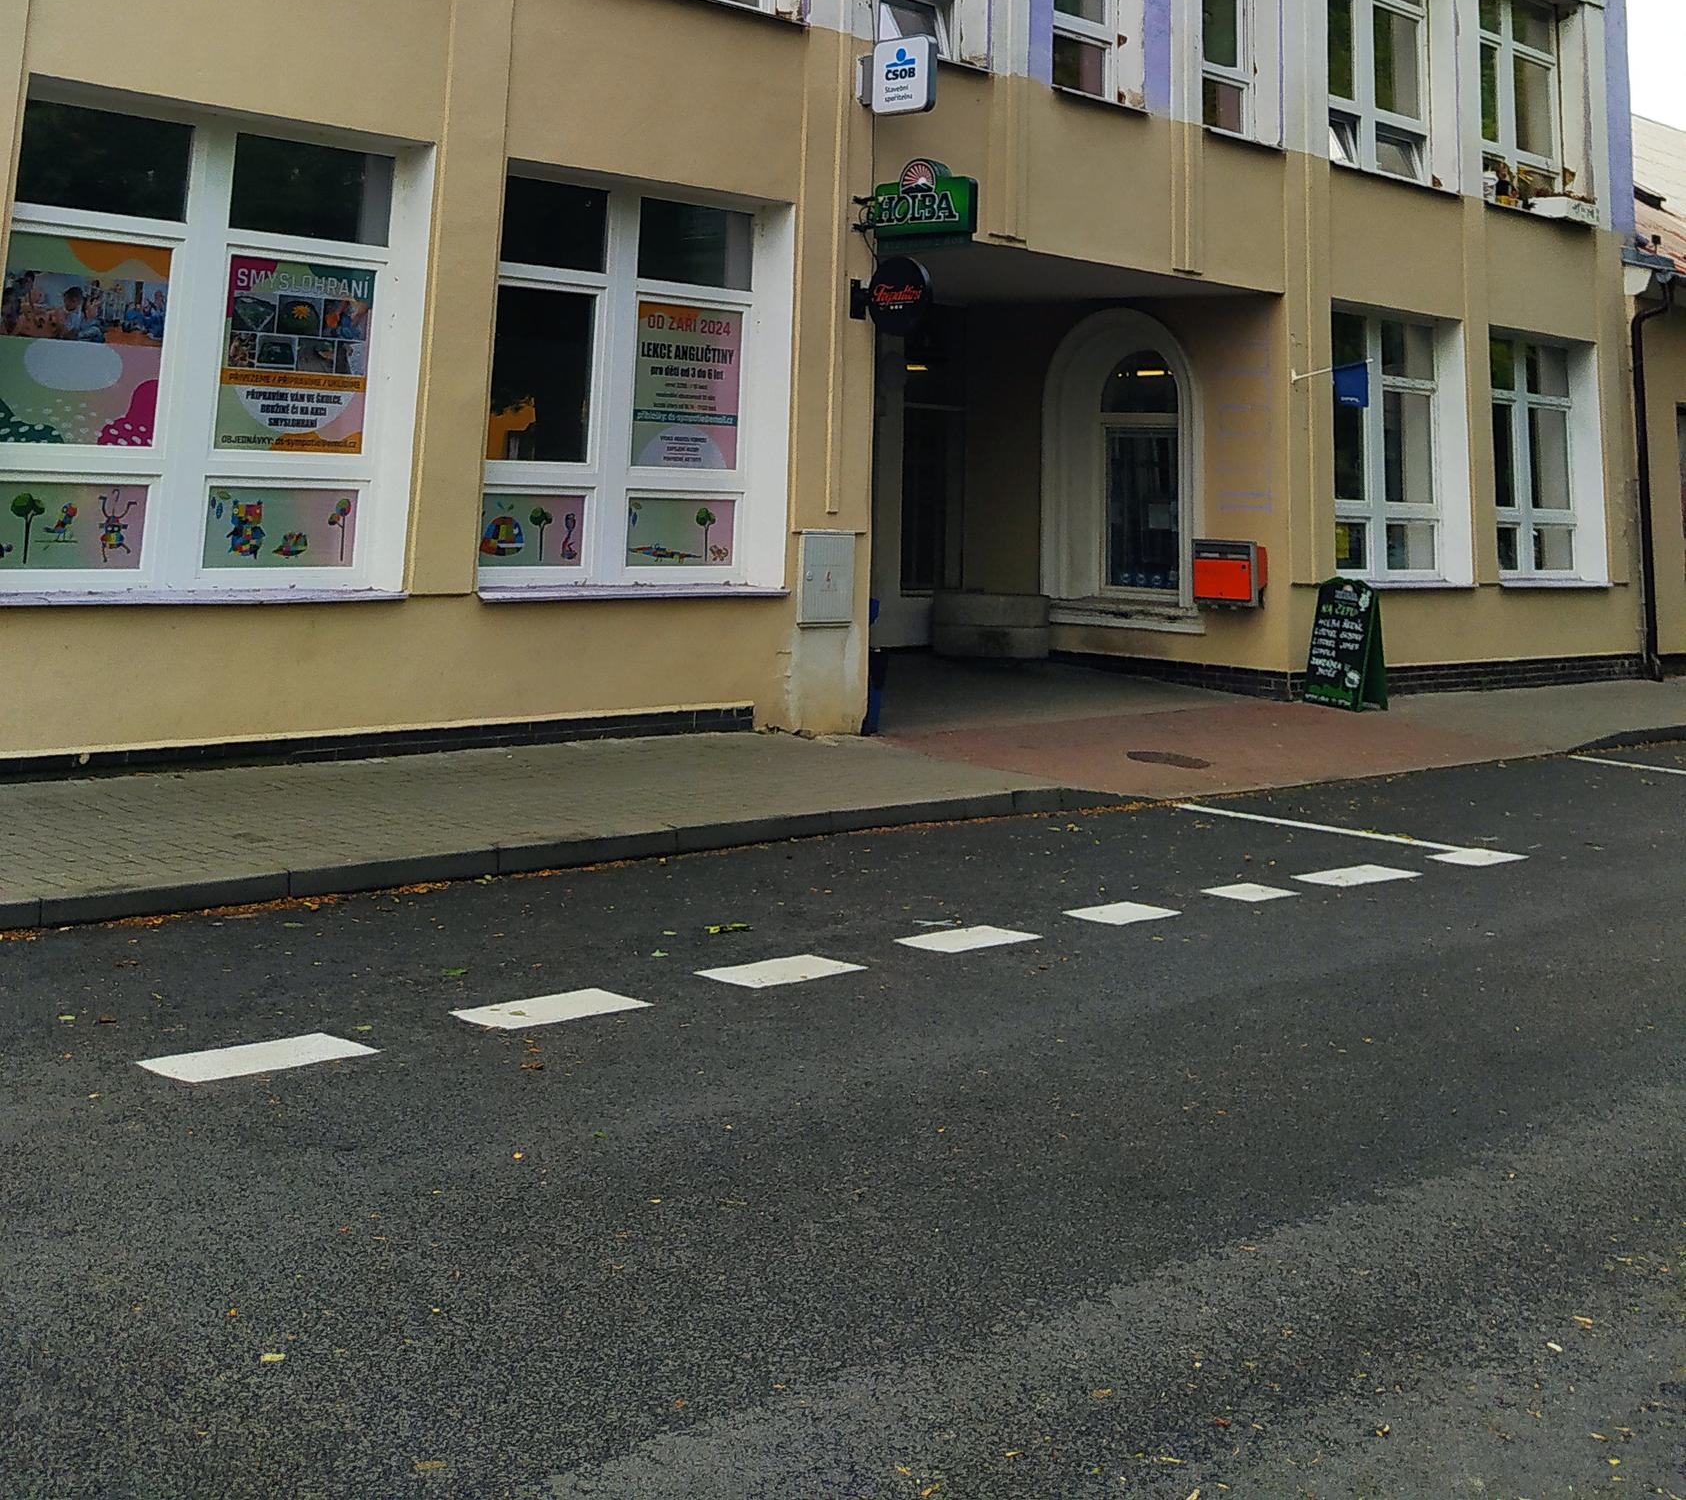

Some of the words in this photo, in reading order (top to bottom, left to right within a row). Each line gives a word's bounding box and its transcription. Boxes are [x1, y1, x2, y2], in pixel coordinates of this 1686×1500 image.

[885, 67, 916, 81] ČSOB
[884, 84, 909, 93] Stavební
[875, 191, 959, 226] HOLBA
[237, 268, 370, 301] SMYSLOHRANÍ
[647, 314, 665, 329] OD
[700, 319, 732, 336] 2024
[641, 341, 673, 360] LEKCE
[674, 343, 735, 365] ANGLIČTINY
[650, 366, 664, 376] pro
[680, 366, 690, 377] od
[691, 368, 696, 378] 3
[707, 369, 713, 380] 6
